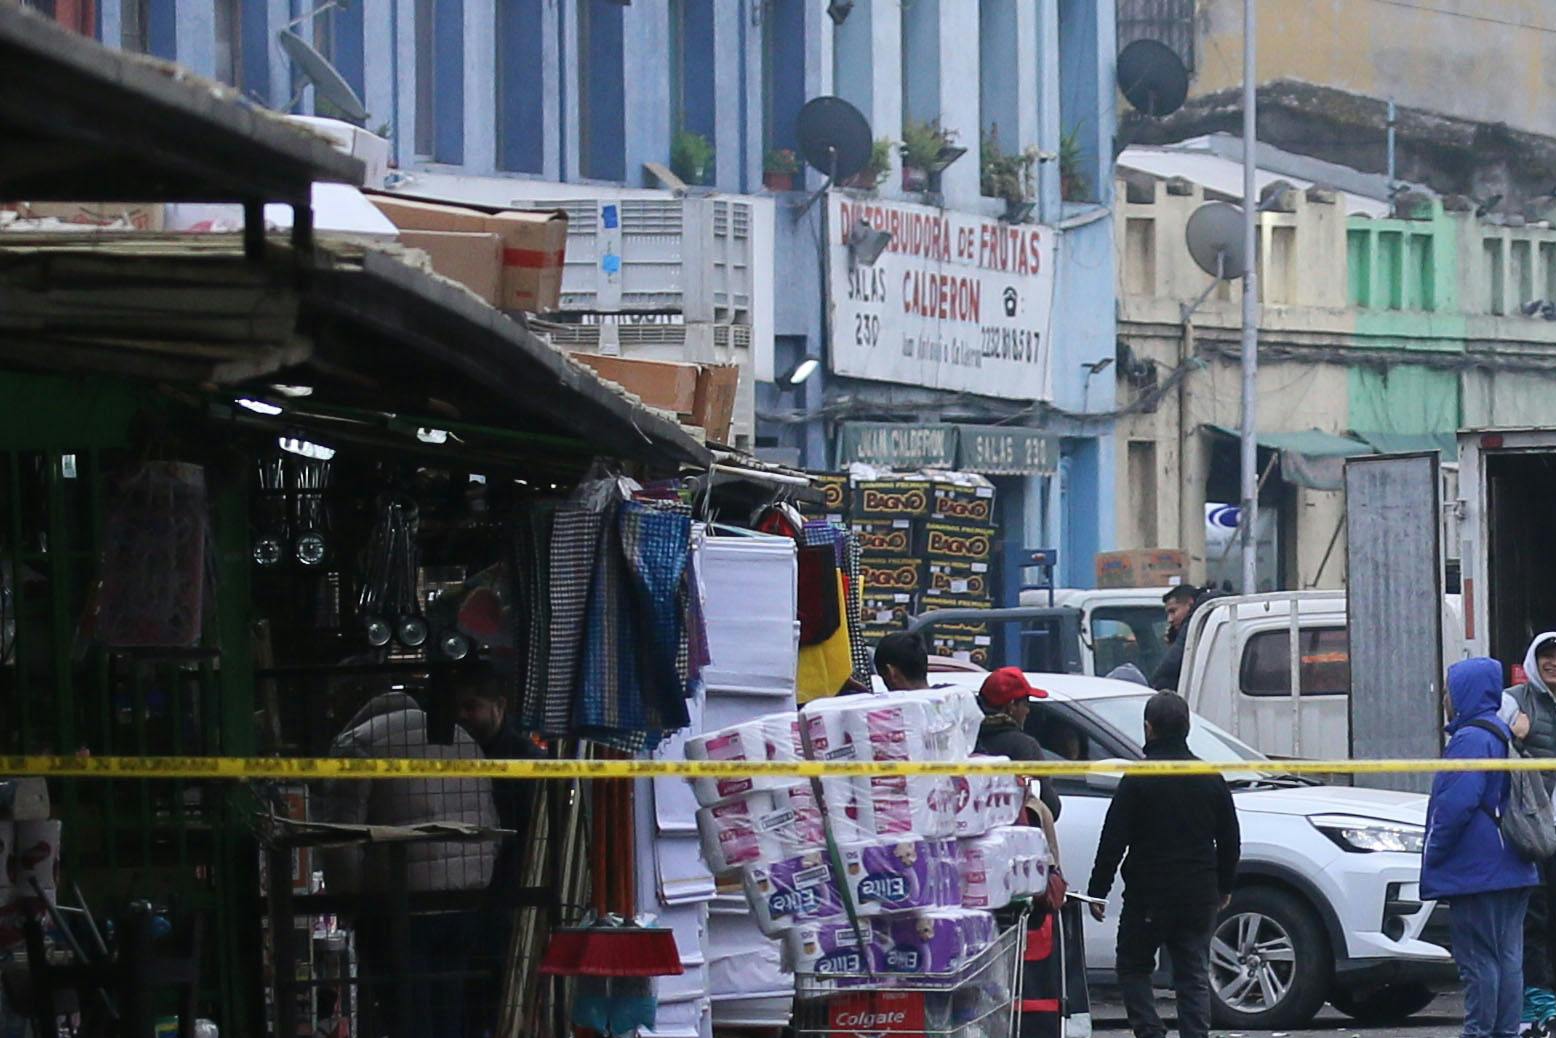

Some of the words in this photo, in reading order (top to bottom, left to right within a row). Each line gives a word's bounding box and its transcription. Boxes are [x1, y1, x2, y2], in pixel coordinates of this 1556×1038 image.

[957, 227, 975, 259] DE
[979, 223, 1040, 275] FRUTAS
[848, 268, 886, 303] SALAS
[903, 269, 980, 324] CALDERON
[855, 312, 879, 347] 230
[976, 435, 1013, 463] SALAS
[864, 489, 926, 512] BAGNO
[937, 498, 988, 519] BAGNO
[928, 531, 989, 557] BAGNO
[862, 877, 904, 897] Elite
[819, 954, 861, 973] Elite
[836, 1010, 906, 1029] Colgate
